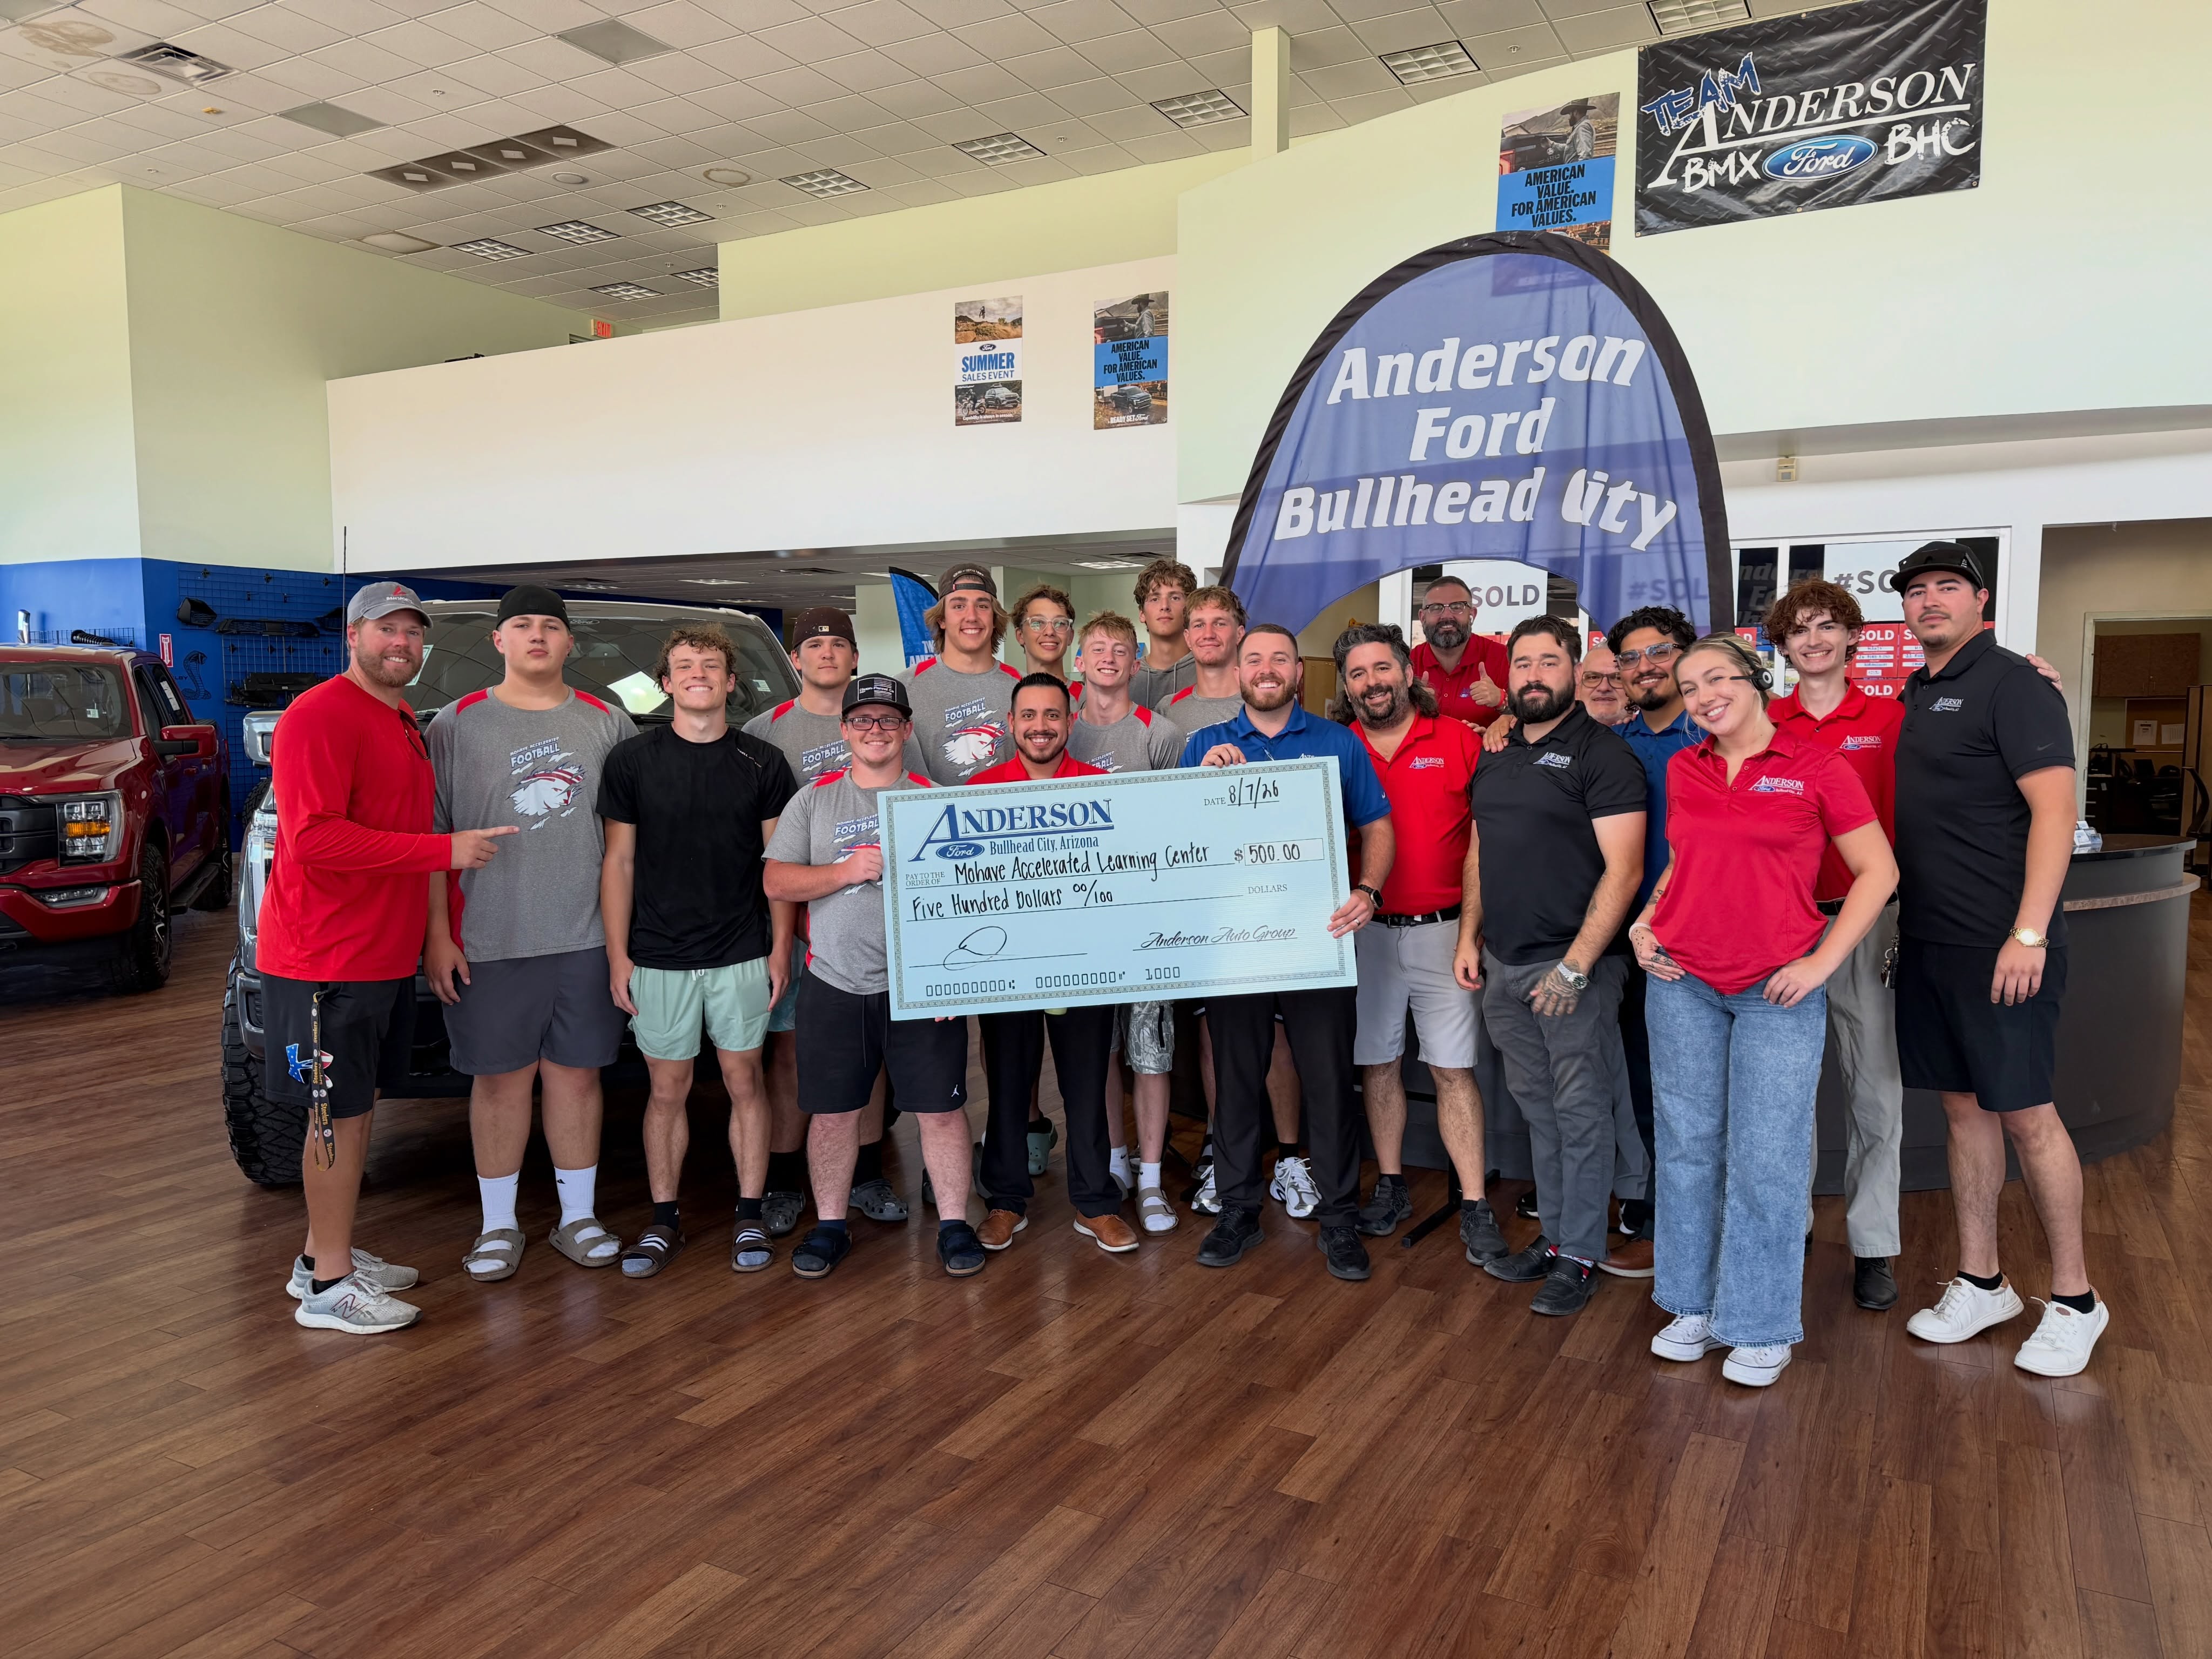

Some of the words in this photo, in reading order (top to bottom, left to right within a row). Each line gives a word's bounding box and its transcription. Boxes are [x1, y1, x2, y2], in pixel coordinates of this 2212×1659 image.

[1641, 52, 1761, 136] TEAM
[1648, 63, 1976, 188] ANDERSON
[1681, 150, 1763, 193] BMX
[1784, 142, 1857, 174] Ford
[1884, 117, 1976, 166] BHC
[1525, 164, 1586, 187] AMERICAN
[1536, 181, 1575, 199] VALUE.
[1512, 201, 1534, 217] FOR
[1536, 191, 1596, 213] AMERICAN
[1532, 208, 1576, 227] VALUES.
[1111, 340, 1149, 354] AMERICAN
[1118, 350, 1143, 363] VALUE.
[961, 352, 1015, 373] SUMMER
[1104, 364, 1117, 374] FOR
[1119, 359, 1157, 373] AMERICAN
[1327, 334, 1645, 405] Anderson
[962, 372, 987, 382] SALES
[988, 370, 1015, 380] EVENT
[1116, 370, 1145, 382] VALUES.
[1110, 415, 1126, 424] READY
[1126, 414, 1135, 422] SET
[1409, 397, 1556, 461] Ford
[1273, 467, 1547, 541] Bullhead
[1834, 569, 1898, 594] #SO
[945, 703, 986, 722] FOOTBALL
[1839, 735, 1881, 749] ANDERSON
[511, 743, 560, 767] FOOTBALL
[802, 745, 845, 765] FOOTBALL
[1092, 757, 1114, 769] BALL
[1409, 756, 1445, 768] ANDERSON
[1229, 777, 1279, 809] 8/7/26
[1748, 775, 1805, 791] ANDERSON
[1204, 798, 1226, 806] DATE
[835, 819, 879, 836] FOOTBAL
[908, 799, 1113, 862] ANDERSON
[946, 845, 975, 858] Ford
[990, 839, 1035, 855] Bullhead
[1037, 837, 1057, 852] City,
[1060, 835, 1100, 850] Arizona
[1235, 848, 1243, 863] $
[1249, 844, 1300, 864] 500.00
[955, 861, 1006, 885] Mohave
[1011, 851, 1090, 880] Accelerated
[1097, 851, 1158, 882] Learning
[1165, 842, 1209, 868] Center
[1248, 884, 1287, 894] DOLLARS
[913, 896, 944, 921] Five
[952, 888, 1009, 915] Hundred
[1016, 888, 1062, 909] Dollars
[1141, 930, 1209, 948] Anderson
[1211, 927, 1250, 943] Auto
[1253, 925, 1296, 942] Group
[1145, 967, 1180, 980] 1000
[321, 1103, 329, 1125] Steelers
